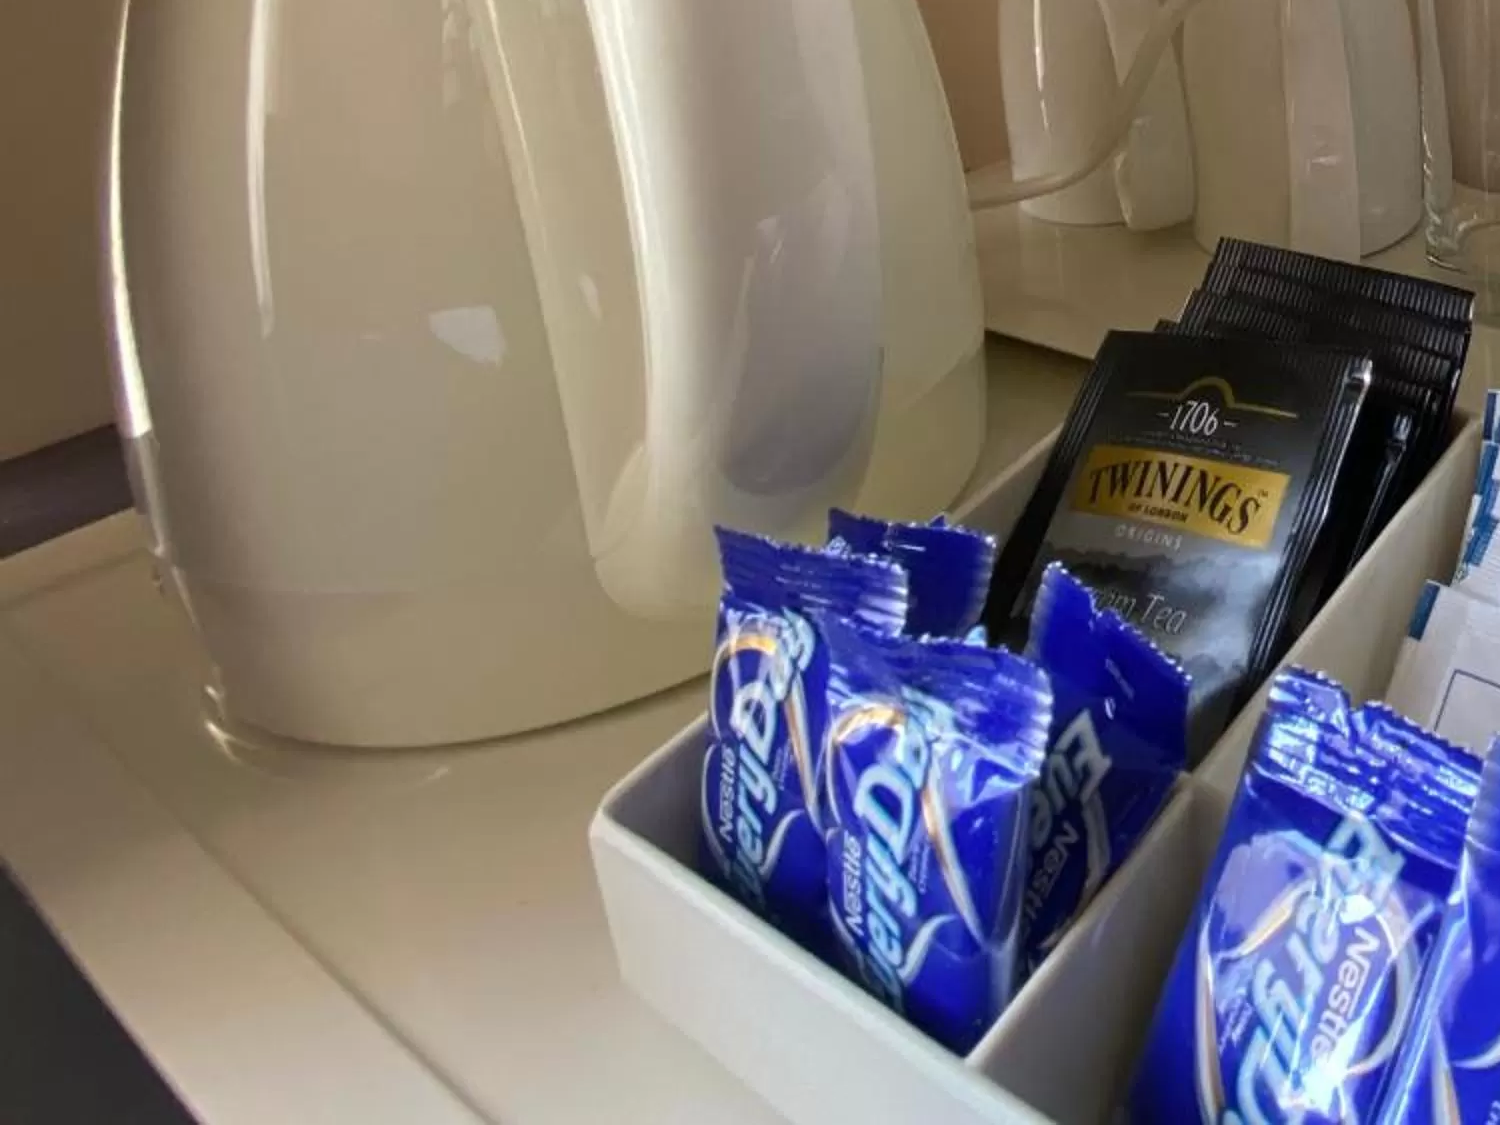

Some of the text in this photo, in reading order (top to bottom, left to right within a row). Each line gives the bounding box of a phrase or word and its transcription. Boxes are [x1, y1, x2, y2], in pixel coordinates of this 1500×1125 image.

[1088, 458, 1262, 536] TWININGS
[1143, 505, 1189, 523] LONDON
[1141, 593, 1187, 634] Tea
[1024, 821, 1081, 921] Nestl
